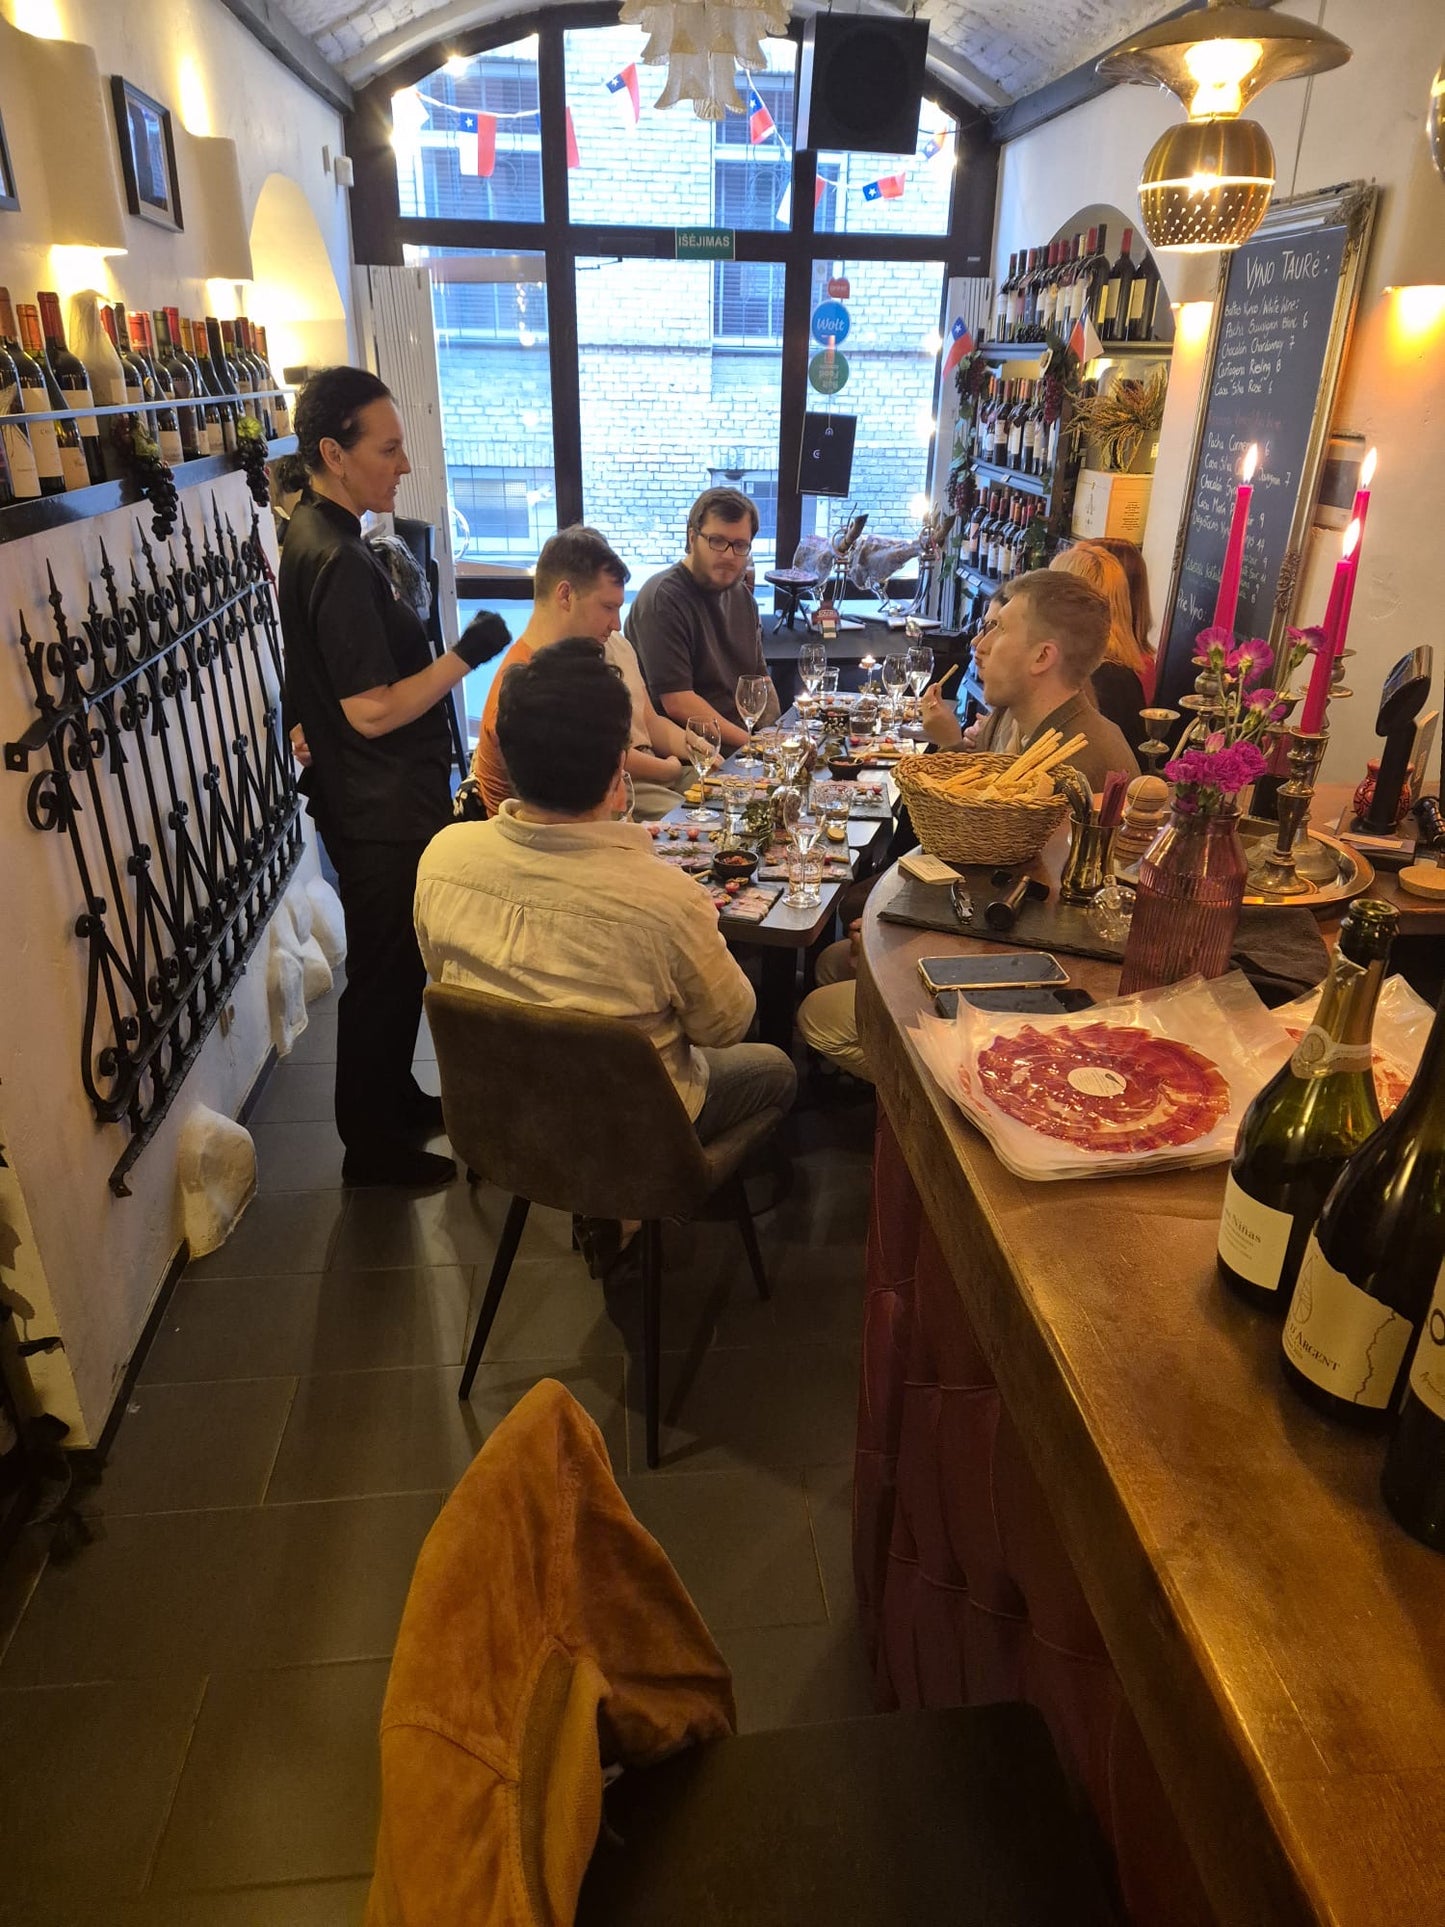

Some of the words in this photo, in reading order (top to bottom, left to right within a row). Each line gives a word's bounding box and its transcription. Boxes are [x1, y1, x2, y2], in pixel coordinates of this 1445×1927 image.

[678, 233, 730, 248] IŠĖJIMAS
[816, 319, 845, 332] Wolt
[1302, 310, 1309, 329] 6
[1260, 512, 1265, 529] 9
